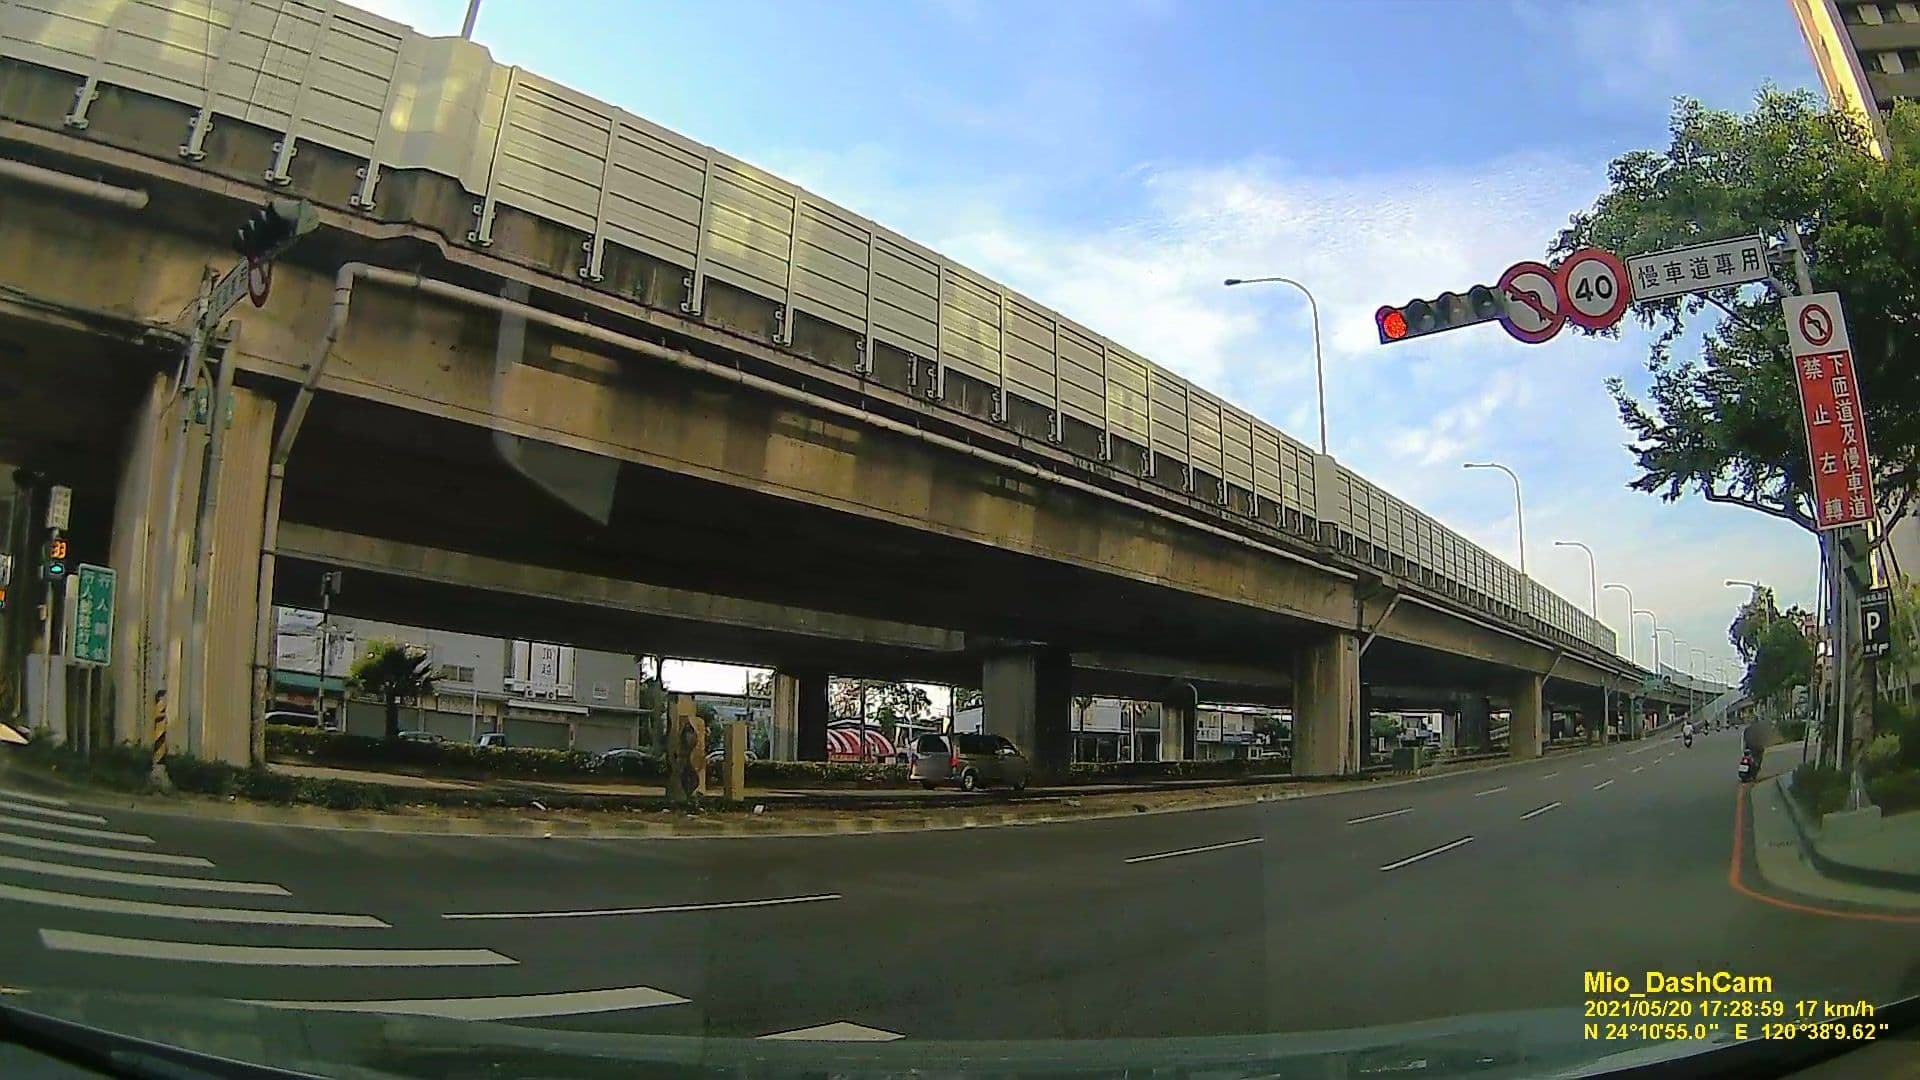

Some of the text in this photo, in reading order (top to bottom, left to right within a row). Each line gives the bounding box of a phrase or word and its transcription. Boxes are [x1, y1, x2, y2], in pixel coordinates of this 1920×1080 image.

[1575, 274, 1613, 302] 40
[1638, 247, 1760, 291] 慢車道專用
[1803, 357, 1844, 521] 禁止左轉
[1826, 353, 1868, 520] 下匝道及慢車道
[1866, 611, 1881, 641] P
